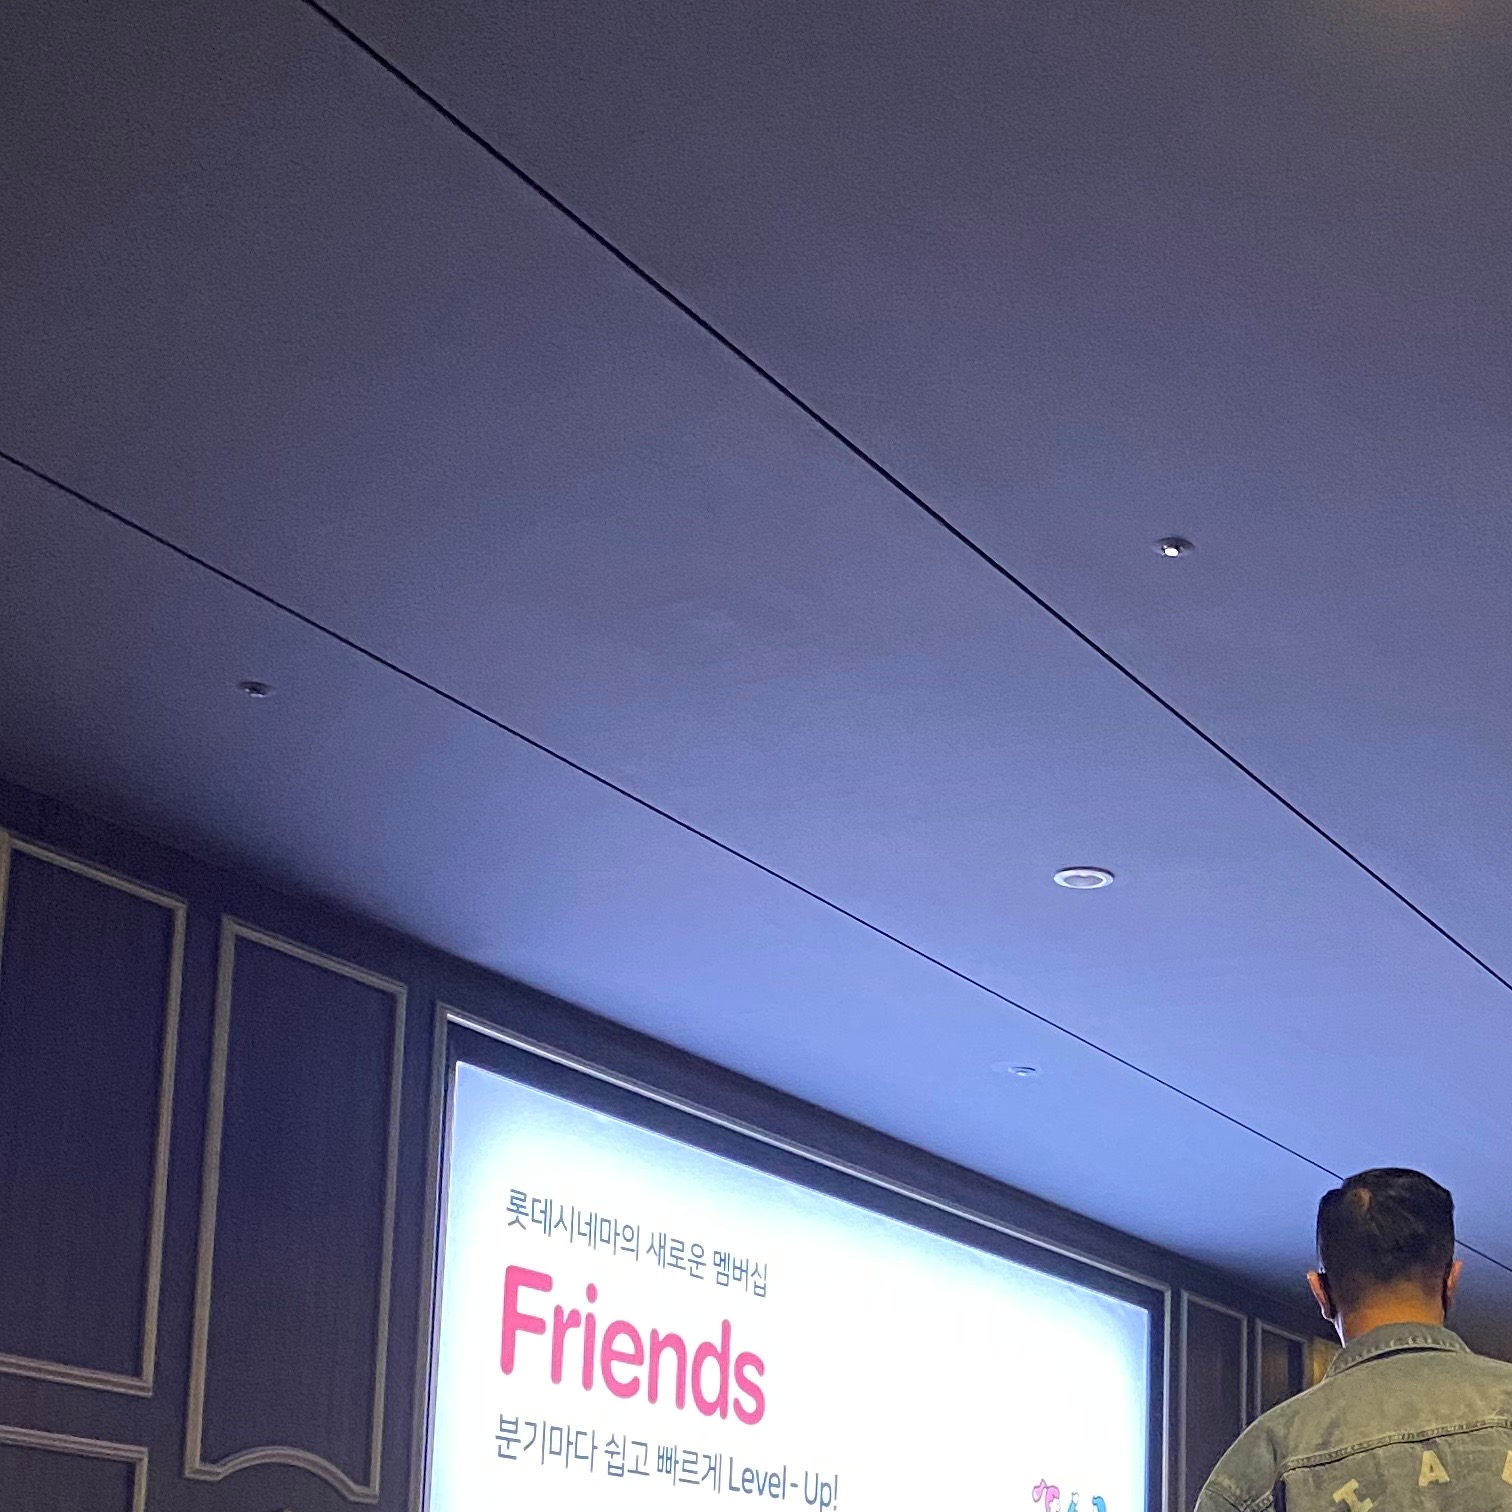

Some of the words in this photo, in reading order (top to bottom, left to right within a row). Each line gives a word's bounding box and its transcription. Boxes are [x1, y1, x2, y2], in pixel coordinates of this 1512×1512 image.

[506, 1188, 640, 1262] 롯데시네마의
[646, 1231, 707, 1280] 새로운
[713, 1250, 768, 1298] 멤버십
[500, 1264, 766, 1425] Friends
[495, 1413, 598, 1473] 분기마다
[604, 1433, 650, 1477] 쉽고
[656, 1444, 722, 1494] 빠르게
